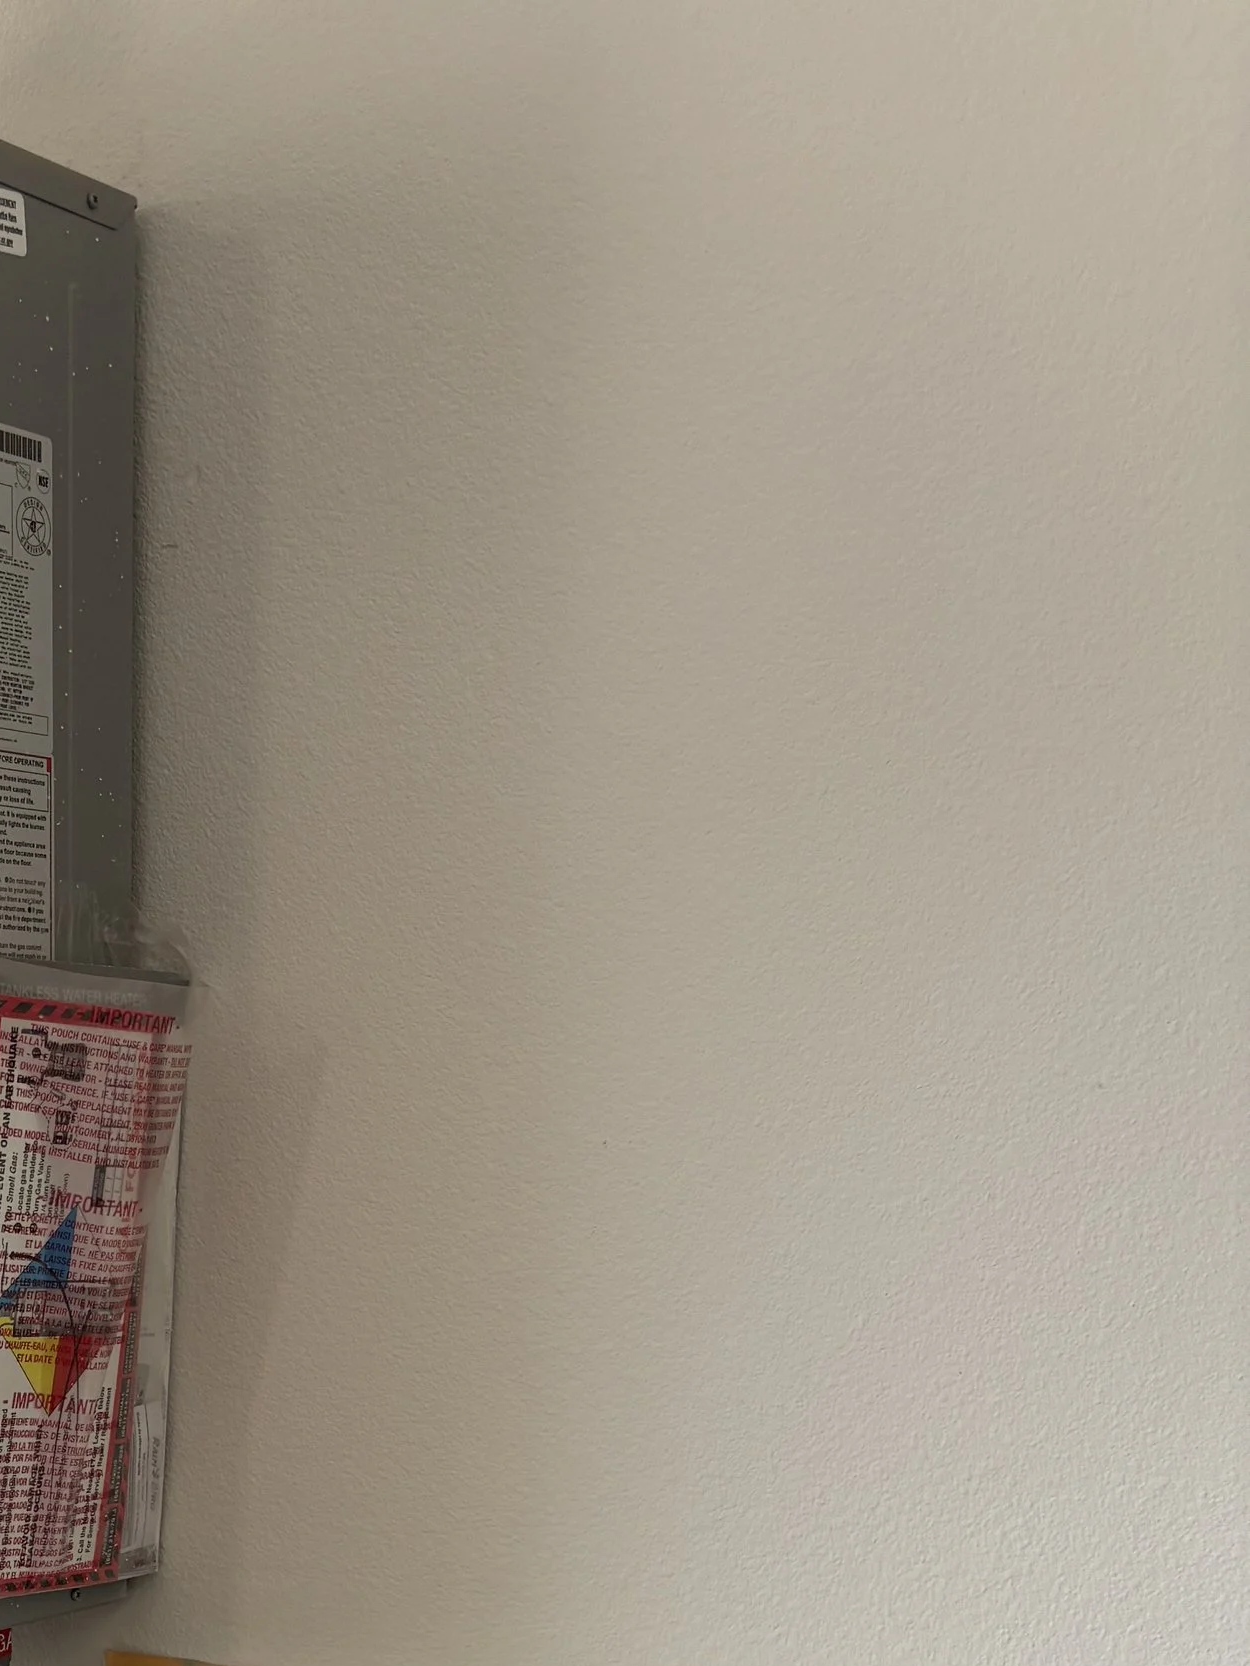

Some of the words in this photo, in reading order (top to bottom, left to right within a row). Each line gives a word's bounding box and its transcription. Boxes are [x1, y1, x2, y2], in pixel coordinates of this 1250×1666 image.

[14, 757, 44, 768] OPERATING
[89, 1005, 176, 1035] IMPORTANT
[51, 1026, 79, 1040] POUCH
[81, 1032, 119, 1047] CONTAINS
[94, 1062, 133, 1076] ATTACHED
[1, 1112, 11, 1129] AN
